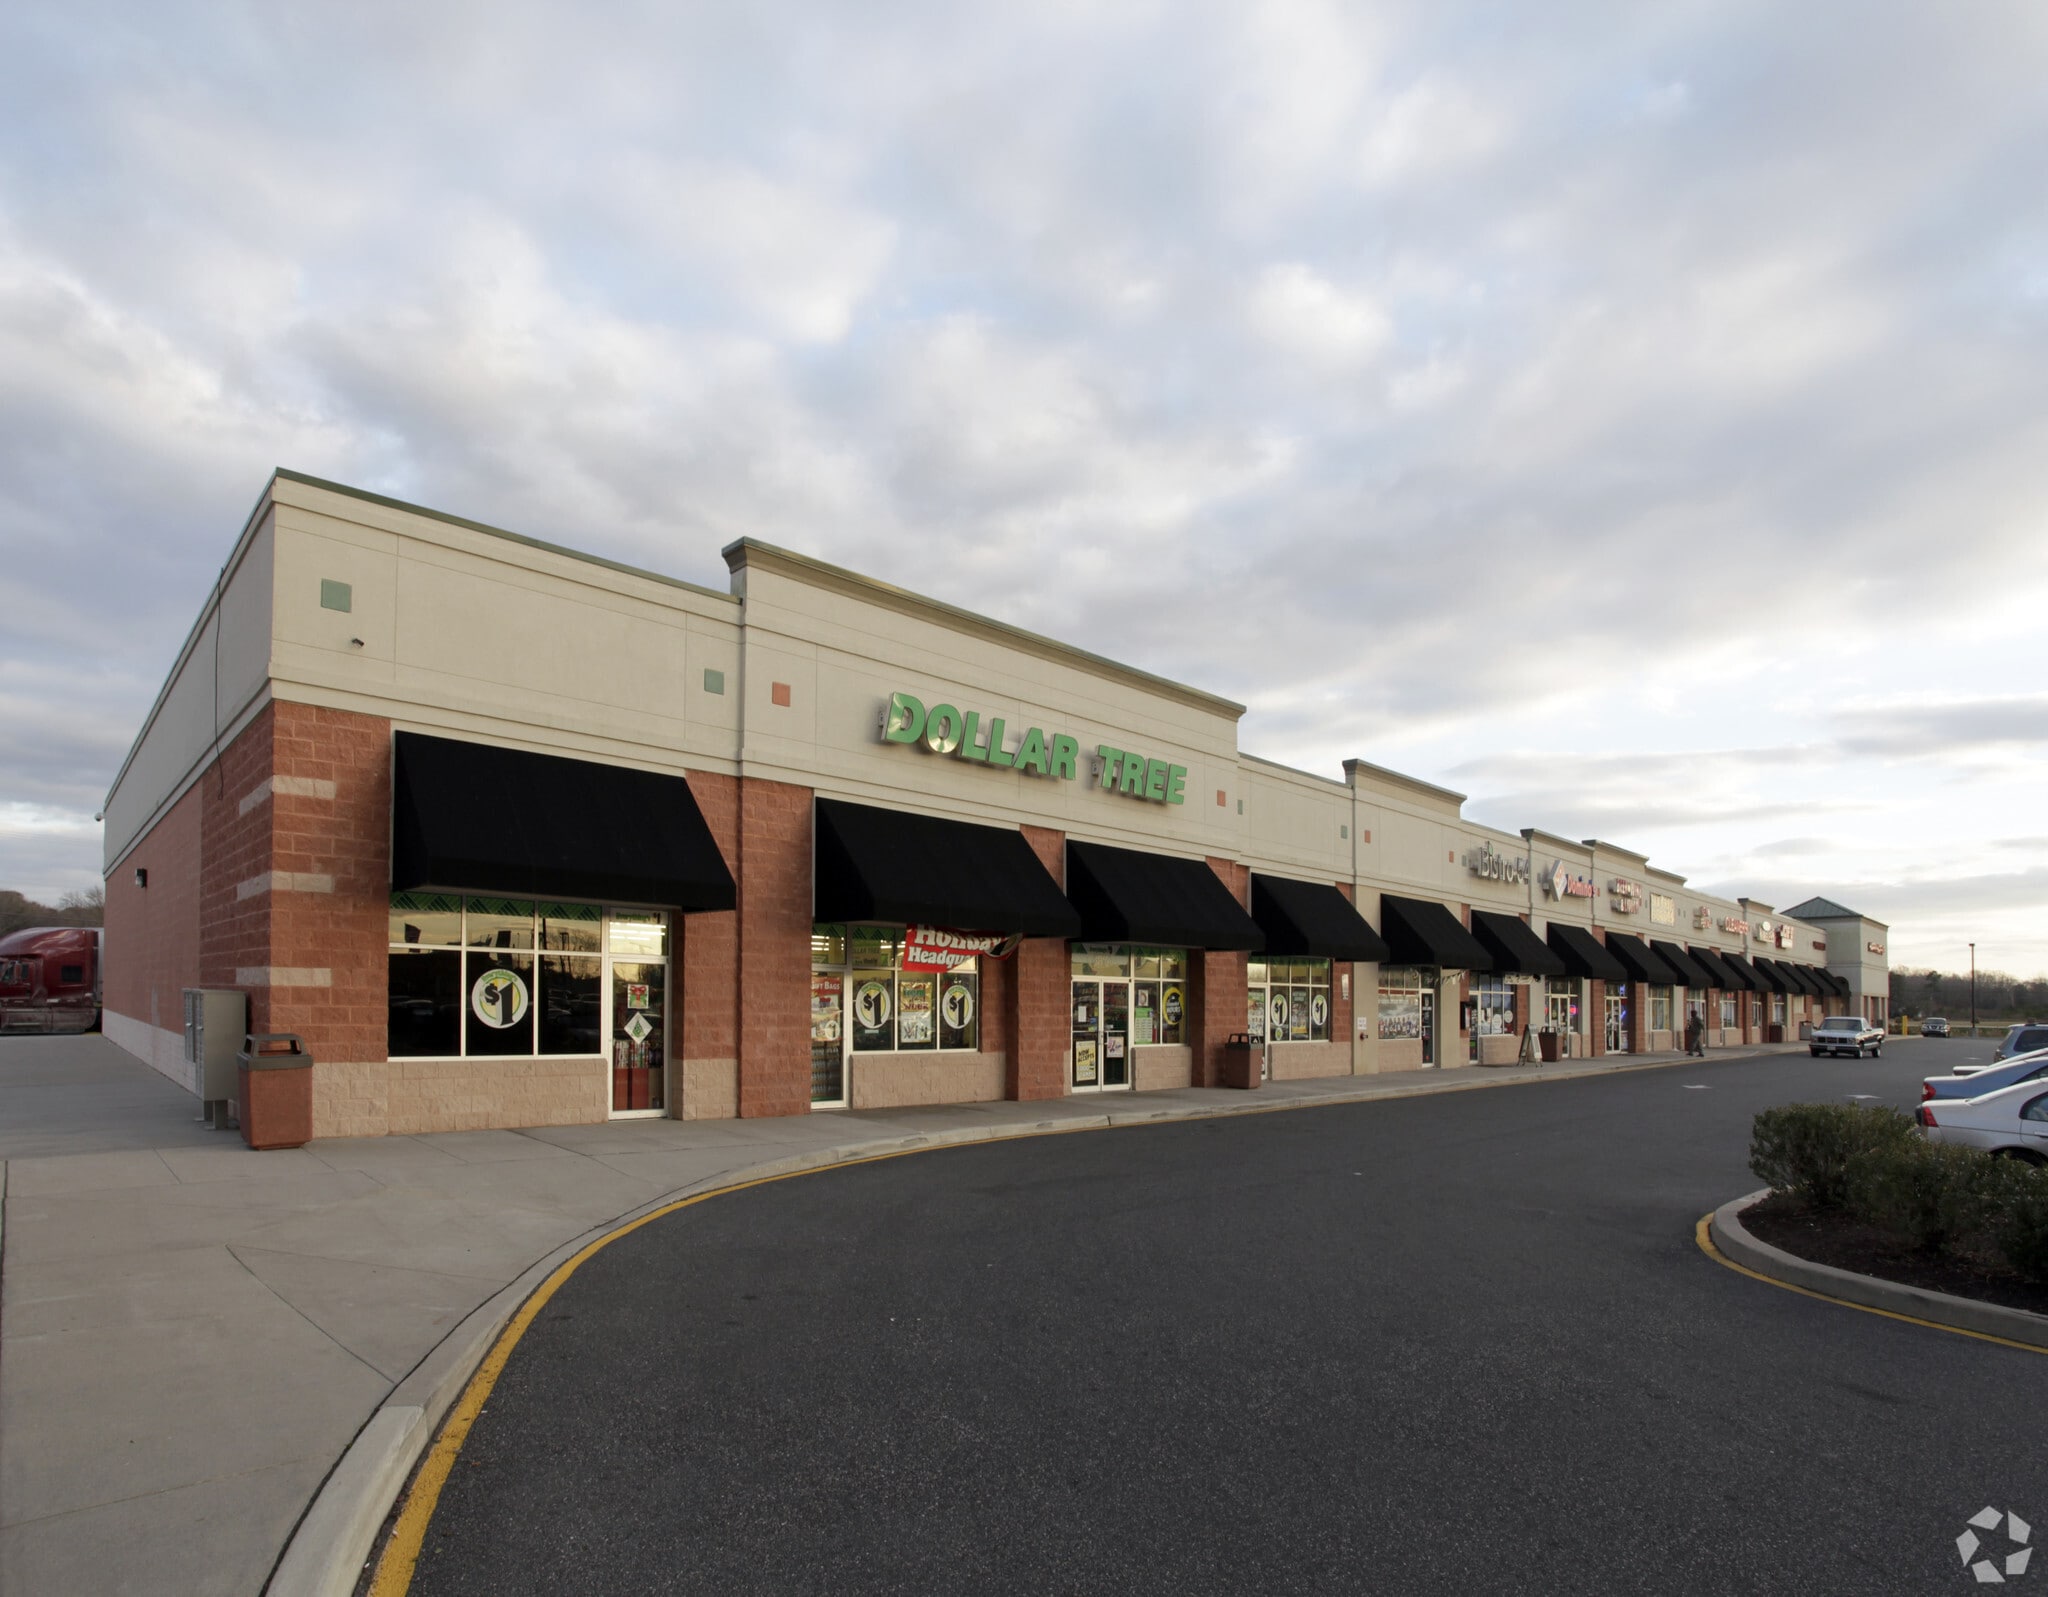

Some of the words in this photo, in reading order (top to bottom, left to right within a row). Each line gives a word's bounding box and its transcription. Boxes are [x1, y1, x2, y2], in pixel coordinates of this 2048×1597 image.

[885, 692, 1079, 780] DOLLAR
[1097, 744, 1188, 805] TREE
[485, 981, 515, 1026] $1
[863, 992, 882, 1027] $1
[949, 995, 965, 1027] $1
